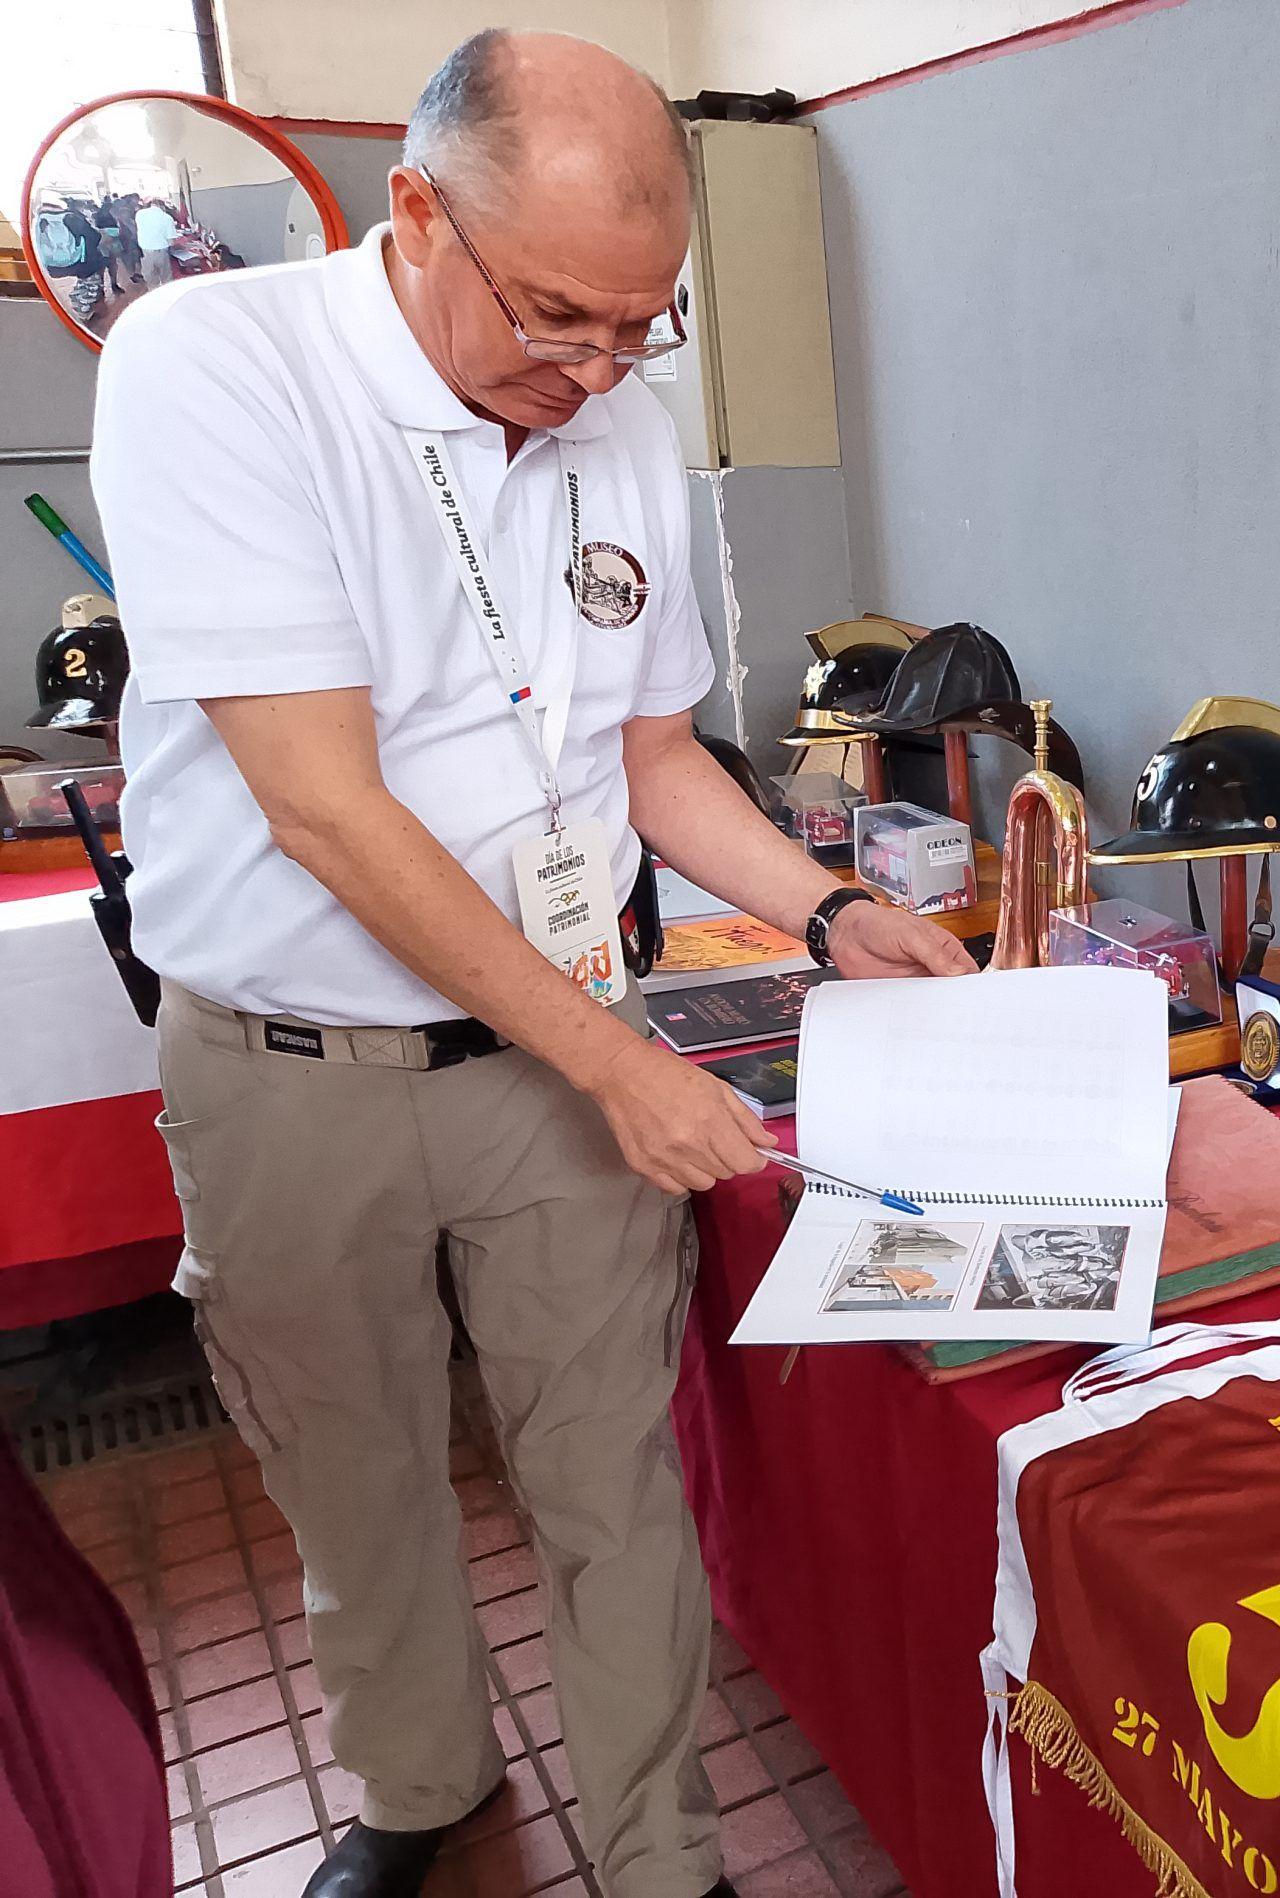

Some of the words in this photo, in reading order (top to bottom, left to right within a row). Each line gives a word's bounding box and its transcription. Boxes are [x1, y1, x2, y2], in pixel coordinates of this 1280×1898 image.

[423, 444, 448, 487] Chile
[440, 489, 457, 509] de
[566, 471, 581, 571] PATRIMONIOS
[445, 511, 480, 574] cultural
[585, 541, 624, 558] MUSEO
[473, 575, 501, 618] fiesta
[492, 620, 505, 641] La
[63, 648, 88, 678] 2
[1136, 753, 1166, 802] 5
[926, 836, 963, 851] ODEON
[537, 853, 585, 882] PATRIMONIOS
[549, 913, 591, 936] PATRIMONIAL
[1112, 1697, 1160, 1757] 27
[1171, 1740, 1278, 1894] MAYO
